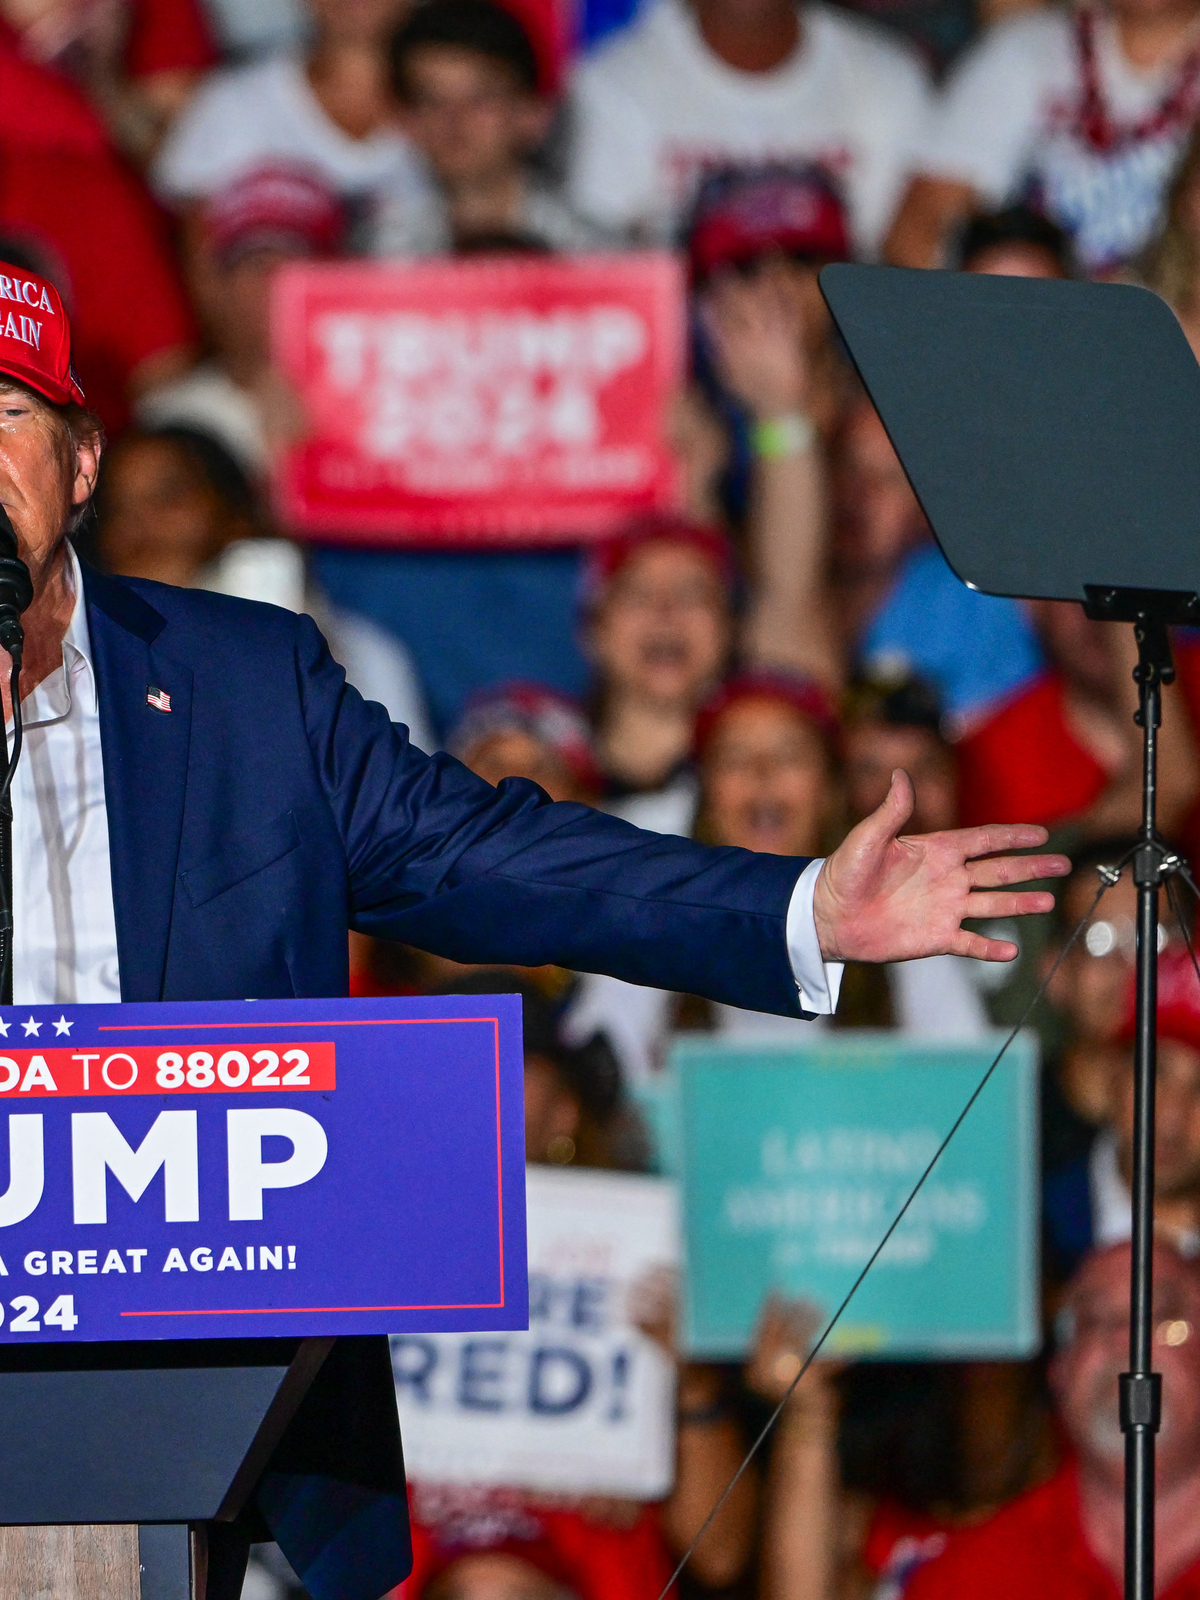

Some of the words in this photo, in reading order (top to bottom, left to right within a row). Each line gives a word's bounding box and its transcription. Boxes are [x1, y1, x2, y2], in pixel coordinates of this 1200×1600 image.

[71, 1053, 139, 1091] TO
[155, 1049, 311, 1089] 88022
[23, 1248, 148, 1276] GREAT
[162, 1245, 297, 1273] AGAIN!
